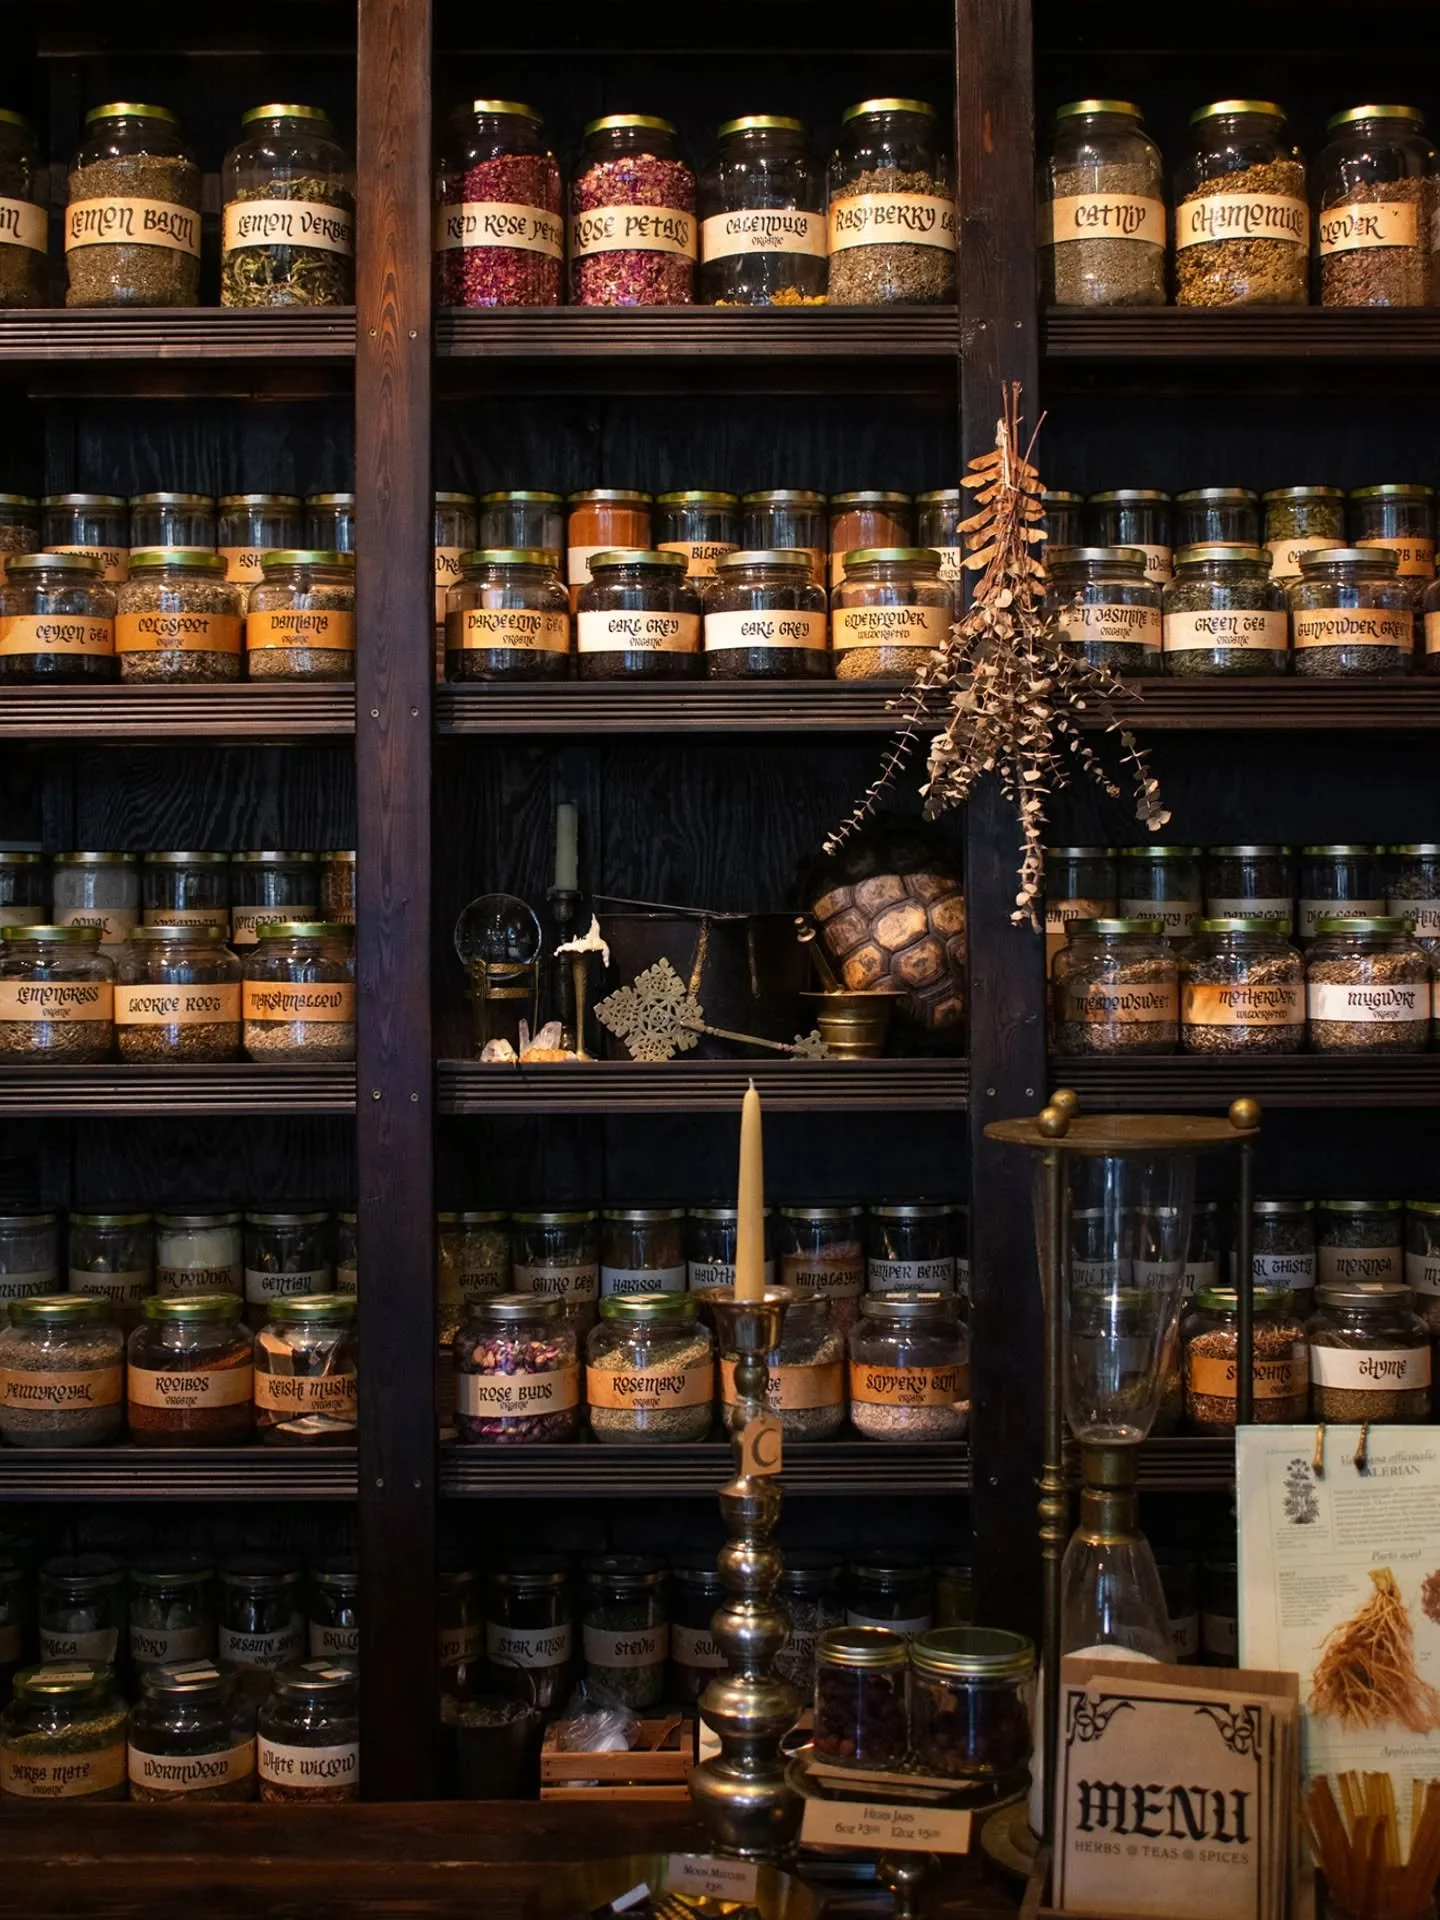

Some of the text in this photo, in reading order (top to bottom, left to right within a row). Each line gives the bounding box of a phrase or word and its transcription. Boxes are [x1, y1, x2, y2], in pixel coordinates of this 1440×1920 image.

[70, 206, 195, 248] LEMON BALM
[235, 212, 293, 237] LEMON
[484, 213, 527, 238] ROSE
[726, 215, 808, 238] CALENDULA
[835, 204, 936, 232] RASPBERRY
[1074, 204, 1146, 234] CATNIP
[1191, 204, 1304, 237] CHAMOMILE
[573, 213, 689, 249] ROSE PETALS
[1319, 213, 1386, 245] CLOVER
[138, 617, 210, 636] COLTSFOOT
[271, 615, 328, 633] DAMIANA
[468, 614, 563, 633] DARJEELING TEA
[608, 618, 679, 637] EARL GREY
[844, 609, 929, 629] ELDERFLOWER
[1095, 607, 1148, 628] JASMINE
[1195, 617, 1265, 634] GREEN TEA
[36, 625, 109, 644] CEYLON TEA
[741, 621, 810, 640] EARL GREY
[1298, 617, 1381, 640] GUNPOWDER
[17, 986, 100, 1006] LEMONGRASS
[128, 997, 222, 1014] LICORICE ROOT
[251, 991, 342, 1012] MARSHMALLOW
[1348, 989, 1416, 1010] MUGWORT
[1336, 1258, 1392, 1276] MORINGA
[262, 1276, 312, 1294] GENTIAN
[459, 1272, 500, 1289] GINGER
[612, 1279, 662, 1292] HARISSA
[1359, 1358, 1407, 1379] THYME
[4, 1382, 95, 1403] PENNYROYAL
[155, 1377, 209, 1394] ROOIBOS
[268, 1379, 304, 1397] REISHI
[479, 1383, 553, 1401] ROSE BUDS
[612, 1375, 686, 1394] ROSEMARY
[866, 1373, 958, 1394] SLIPPERY ELM
[1366, 1465, 1421, 1478] ALERIAN
[500, 1638, 533, 1657] STAR
[615, 1638, 655, 1656] STEVIA
[9, 1763, 90, 1784] YERBA MATE
[144, 1759, 229, 1784] WORMWOOD
[263, 1751, 356, 1776] WHITE WILLOW
[1076, 1779, 1251, 1844] MENU
[1074, 1840, 1249, 1865] HERBS TEAS SPICES
